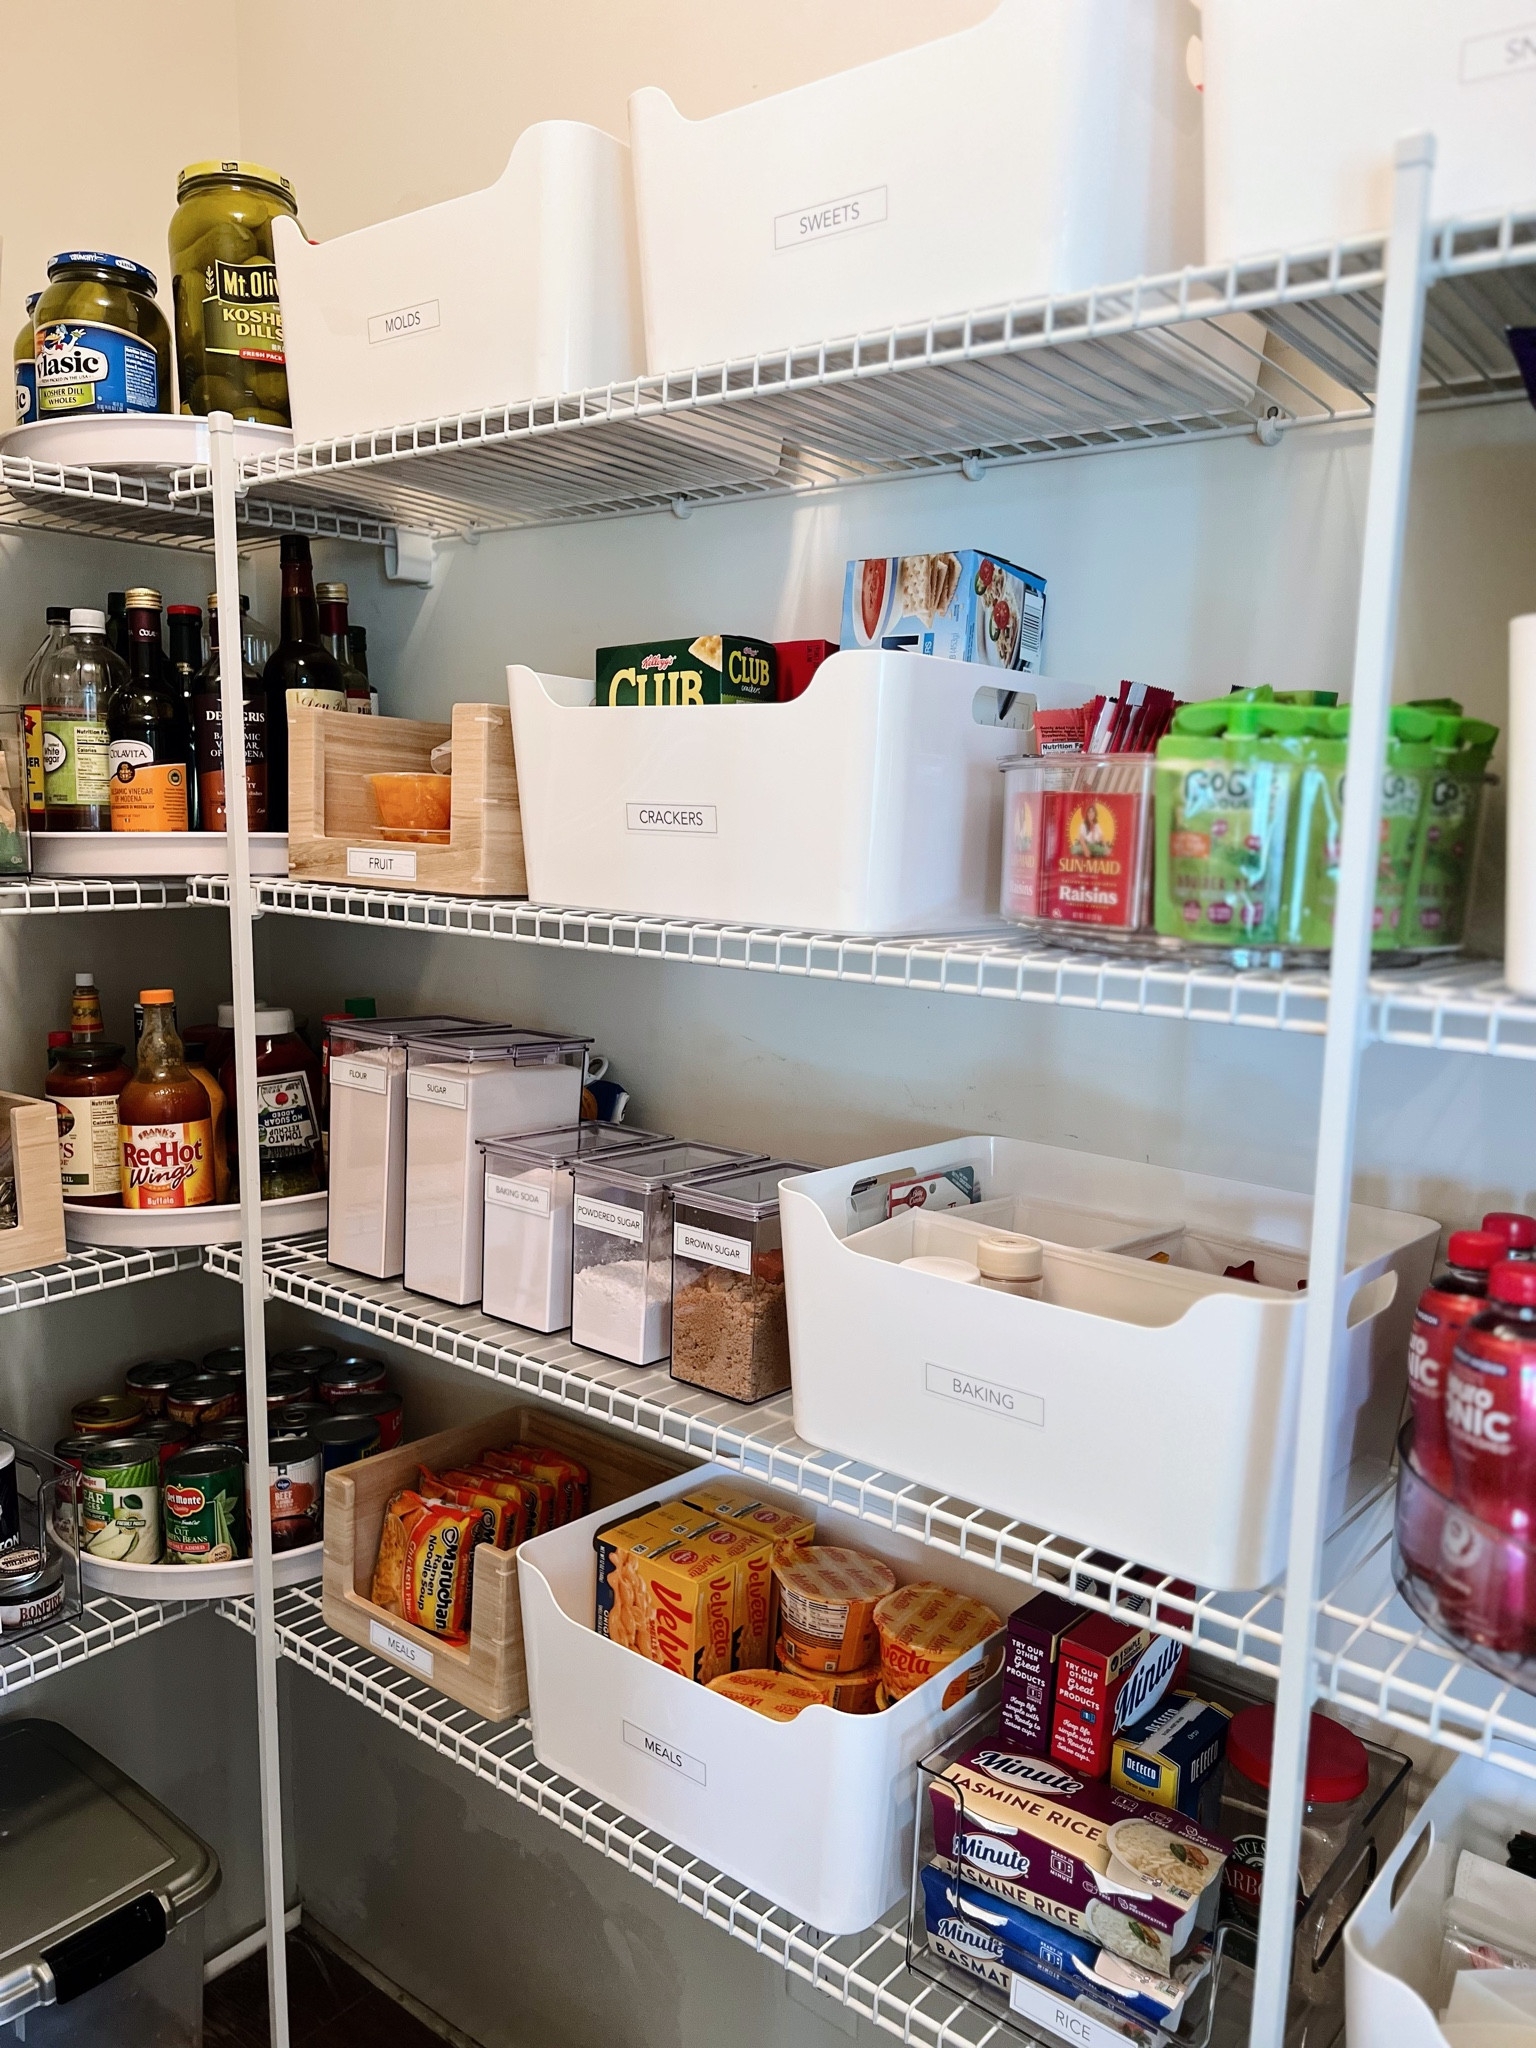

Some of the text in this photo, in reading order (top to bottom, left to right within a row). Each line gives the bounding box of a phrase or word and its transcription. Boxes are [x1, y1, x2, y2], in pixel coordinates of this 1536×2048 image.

[799, 202, 860, 235] SWEETS
[224, 308, 283, 328] KOSHE
[385, 311, 420, 334] MOLDS
[37, 350, 99, 379] Vlasic
[243, 350, 284, 362] FRESH PACK
[44, 386, 84, 398] KOSHER DILL
[48, 396, 76, 405] WHOLES
[729, 651, 770, 688] CLUB
[120, 794, 142, 802] MODENA
[129, 788, 154, 796] VINEGAR
[639, 810, 704, 827] CRACKERS
[369, 857, 394, 870] FRUIT
[1059, 886, 1118, 905] Raisins
[349, 1070, 367, 1080] FLOUR
[427, 1084, 446, 1094] SUGAR
[264, 1114, 303, 1127] NO SUGAR
[272, 1109, 294, 1118] ADDED
[138, 1128, 176, 1141] FRANK'S
[269, 1124, 300, 1136] KETCHUP
[269, 1130, 302, 1144] TOMATO
[124, 1142, 202, 1168] RedHot
[130, 1163, 198, 1189] Wings
[148, 1197, 174, 1205] Buffalo
[496, 1185, 539, 1203] BAKING SODA
[577, 1204, 640, 1230] POWDERED SUGAR
[685, 1236, 740, 1259] BROWN SUGAR
[953, 1377, 1014, 1410] BAKING
[176, 1494, 202, 1505] Monte
[275, 1491, 292, 1500] BEEF
[174, 1527, 189, 1536] CUT
[183, 1534, 208, 1543] BEANS
[405, 1540, 417, 1584] Chicken
[418, 1534, 437, 1610] Noodle Soup
[688, 1554, 722, 1578] Velveeta
[428, 1554, 442, 1596] Ramen
[436, 1527, 460, 1630] Maruchan
[20, 1591, 64, 1620] BONFIRE
[746, 1556, 768, 1638] Velveeta
[708, 1576, 732, 1660] Velveeta
[387, 1636, 416, 1662] MEALS
[1012, 1638, 1044, 1657] TRY OUR
[1016, 1648, 1038, 1662] OTHER
[1014, 1654, 1041, 1674] Great
[1065, 1660, 1098, 1680] TRY OUR
[728, 1674, 776, 1690] Velveeta
[1006, 1666, 1046, 1687] PRODUCTS
[1067, 1677, 1095, 1696] Great
[1069, 1670, 1093, 1684] OTHER
[1010, 1696, 1037, 1712] Keep life
[1059, 1688, 1100, 1711] PRODUCTS
[1002, 1710, 1041, 1731] our Ready to
[1005, 1703, 1040, 1722] simple with
[1004, 1718, 1037, 1738] Serve cups.
[1058, 1726, 1094, 1746] simple with
[1062, 1719, 1091, 1736] Keep life
[644, 1736, 683, 1768] MEALS
[1054, 1733, 1095, 1755] our Ready to
[1056, 1742, 1091, 1763] Serve cups.
[972, 1752, 1083, 1794] Minute
[950, 1773, 1102, 1842] JASMINE RICE
[953, 1834, 1030, 1872] Minute
[1051, 1850, 1066, 1860] READY
[1050, 1870, 1074, 1884] MINUTE
[946, 1860, 1080, 1928] JASMINE RICE
[1129, 1907, 1167, 1929] PRESERVATIVES
[938, 1918, 1004, 1957] Minute
[936, 1942, 1010, 1988] BASMAT
[1056, 2009, 1092, 2042] RICE
